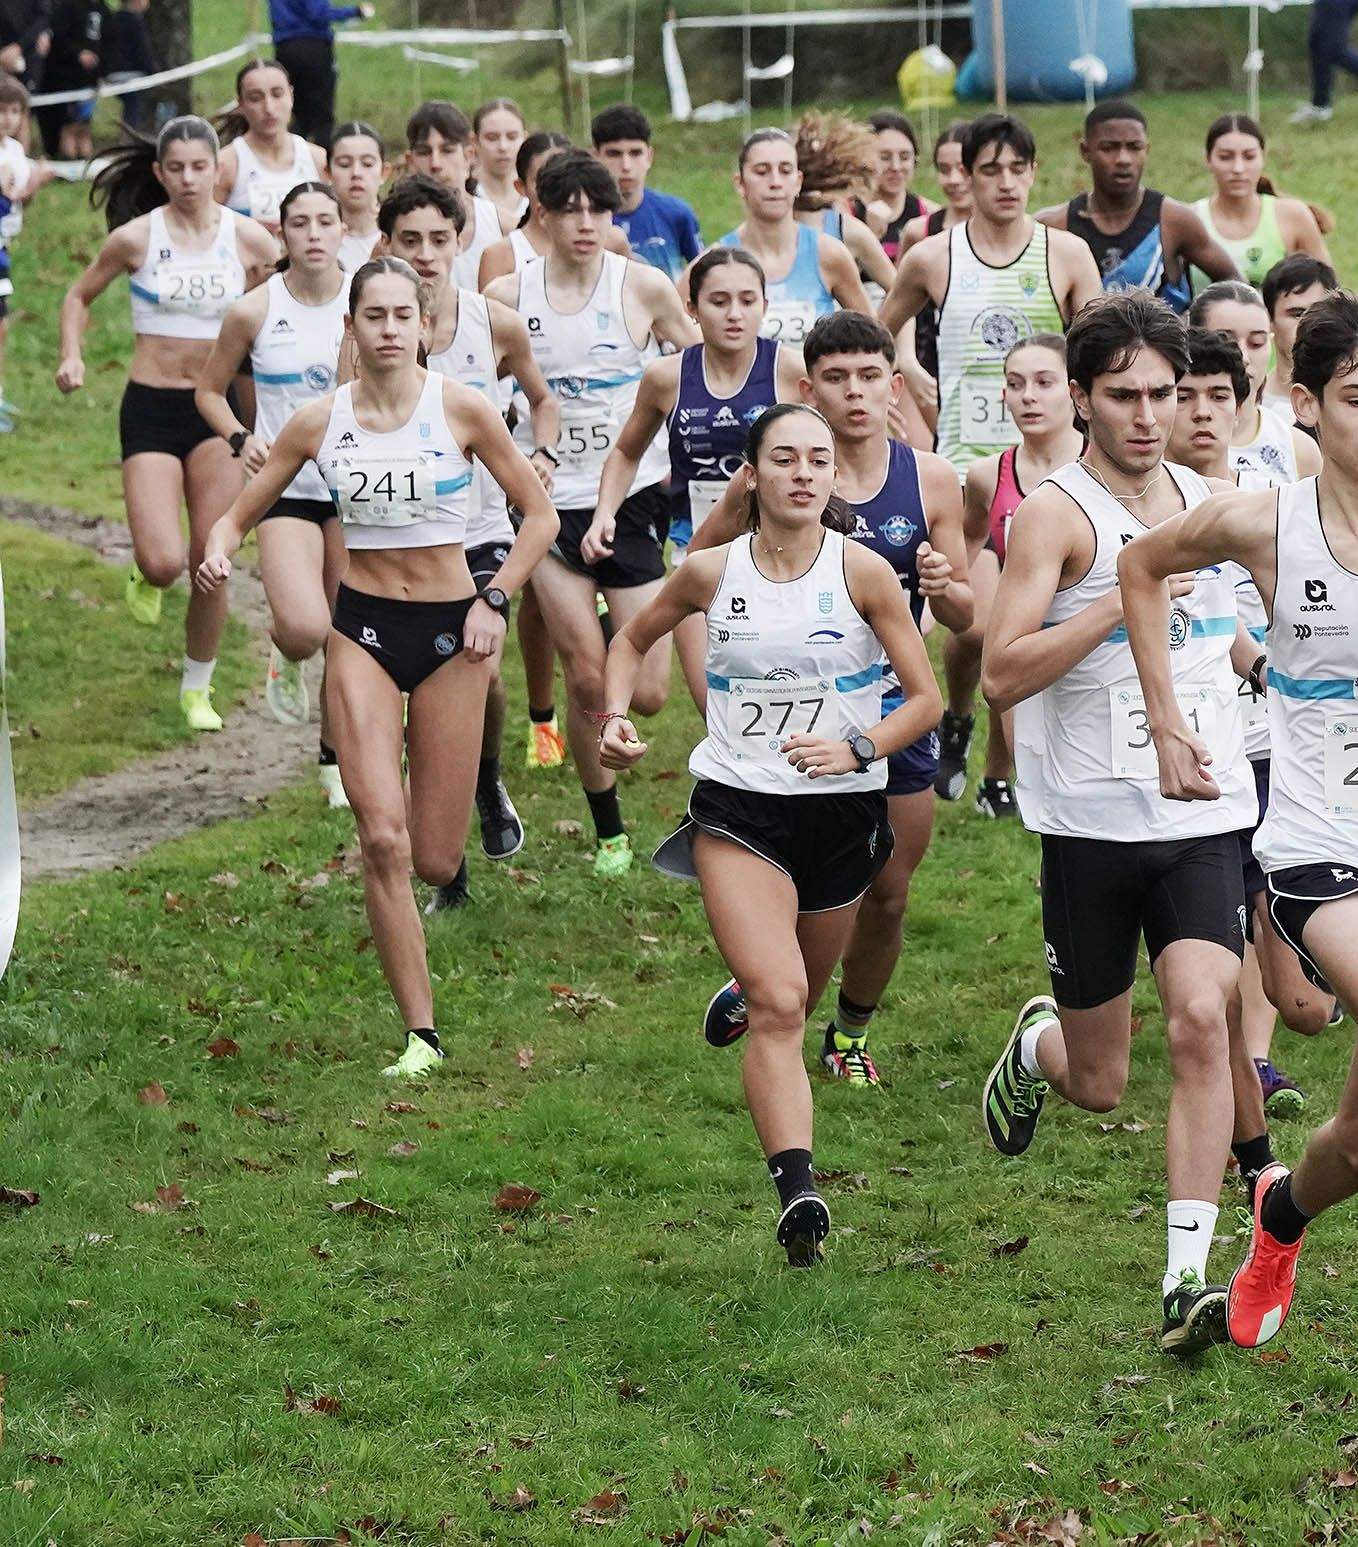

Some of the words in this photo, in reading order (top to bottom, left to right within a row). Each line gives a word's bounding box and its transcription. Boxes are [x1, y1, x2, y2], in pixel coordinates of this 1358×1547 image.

[170, 273, 225, 301] 285
[769, 317, 805, 342] 23
[972, 396, 1011, 424] 31
[557, 424, 610, 455] 55
[349, 470, 422, 503] 241
[741, 698, 824, 737] 277
[1127, 708, 1200, 749] 31
